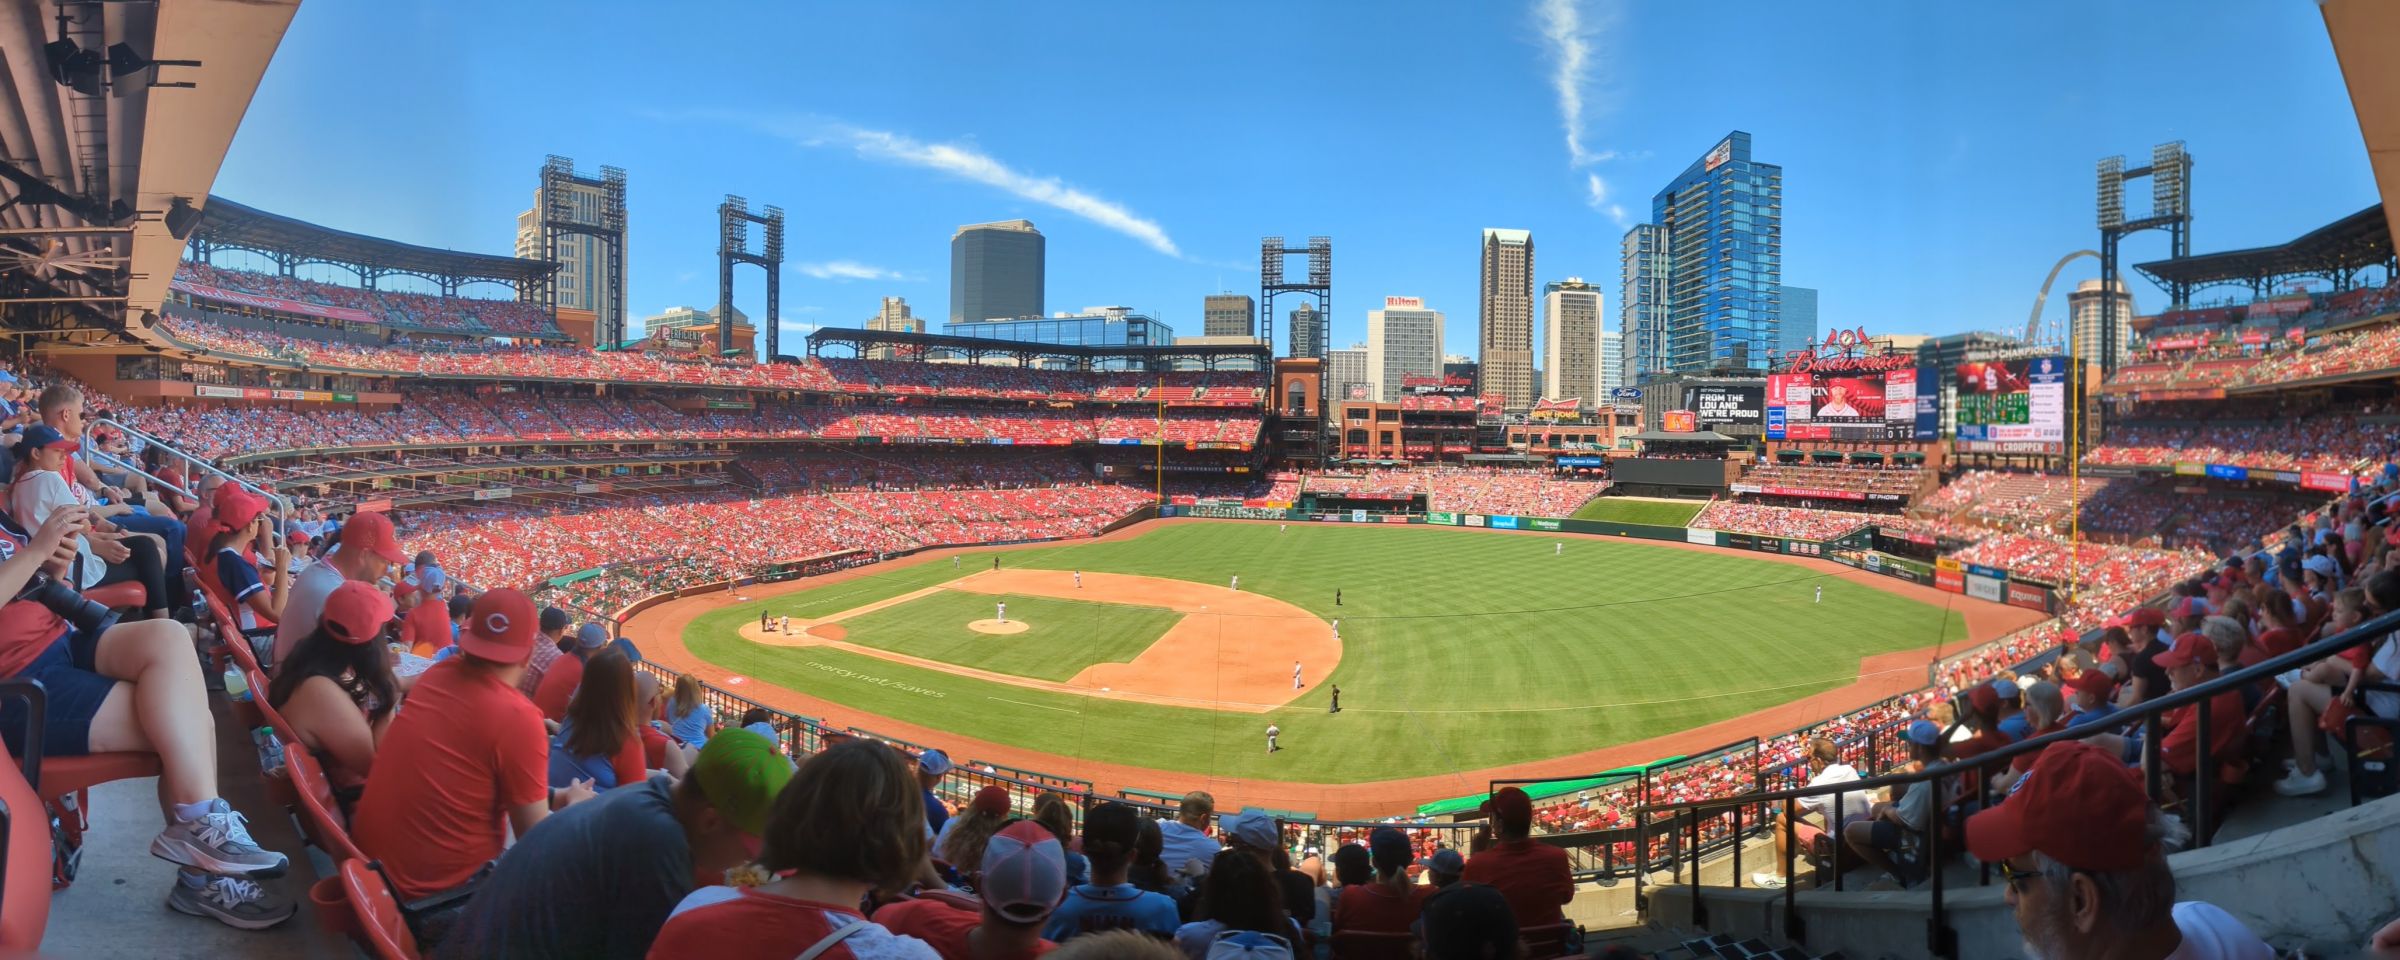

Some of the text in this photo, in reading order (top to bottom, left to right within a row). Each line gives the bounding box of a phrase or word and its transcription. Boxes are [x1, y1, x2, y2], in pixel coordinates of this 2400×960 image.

[1387, 297, 1418, 306] Hilton
[1999, 346, 2054, 359] CHAMPIONS
[1786, 350, 1912, 373] Budweiser
[1616, 388, 1638, 397] Ford
[1811, 387, 1828, 396] CIN
[1700, 394, 1744, 402] FROM THE
[1700, 402, 1738, 410] LOU AND
[1555, 411, 1580, 419] HOUSE
[1700, 410, 1759, 418] WE'RE PROUD
[1887, 430, 1894, 439] 0
[1907, 430, 1914, 439] 2
[2003, 442, 2044, 452] CROUPPEN
[1783, 488, 1821, 497] SCOREBOARD
[486, 612, 510, 633] C
[805, 660, 947, 699] mercy.net/saves
